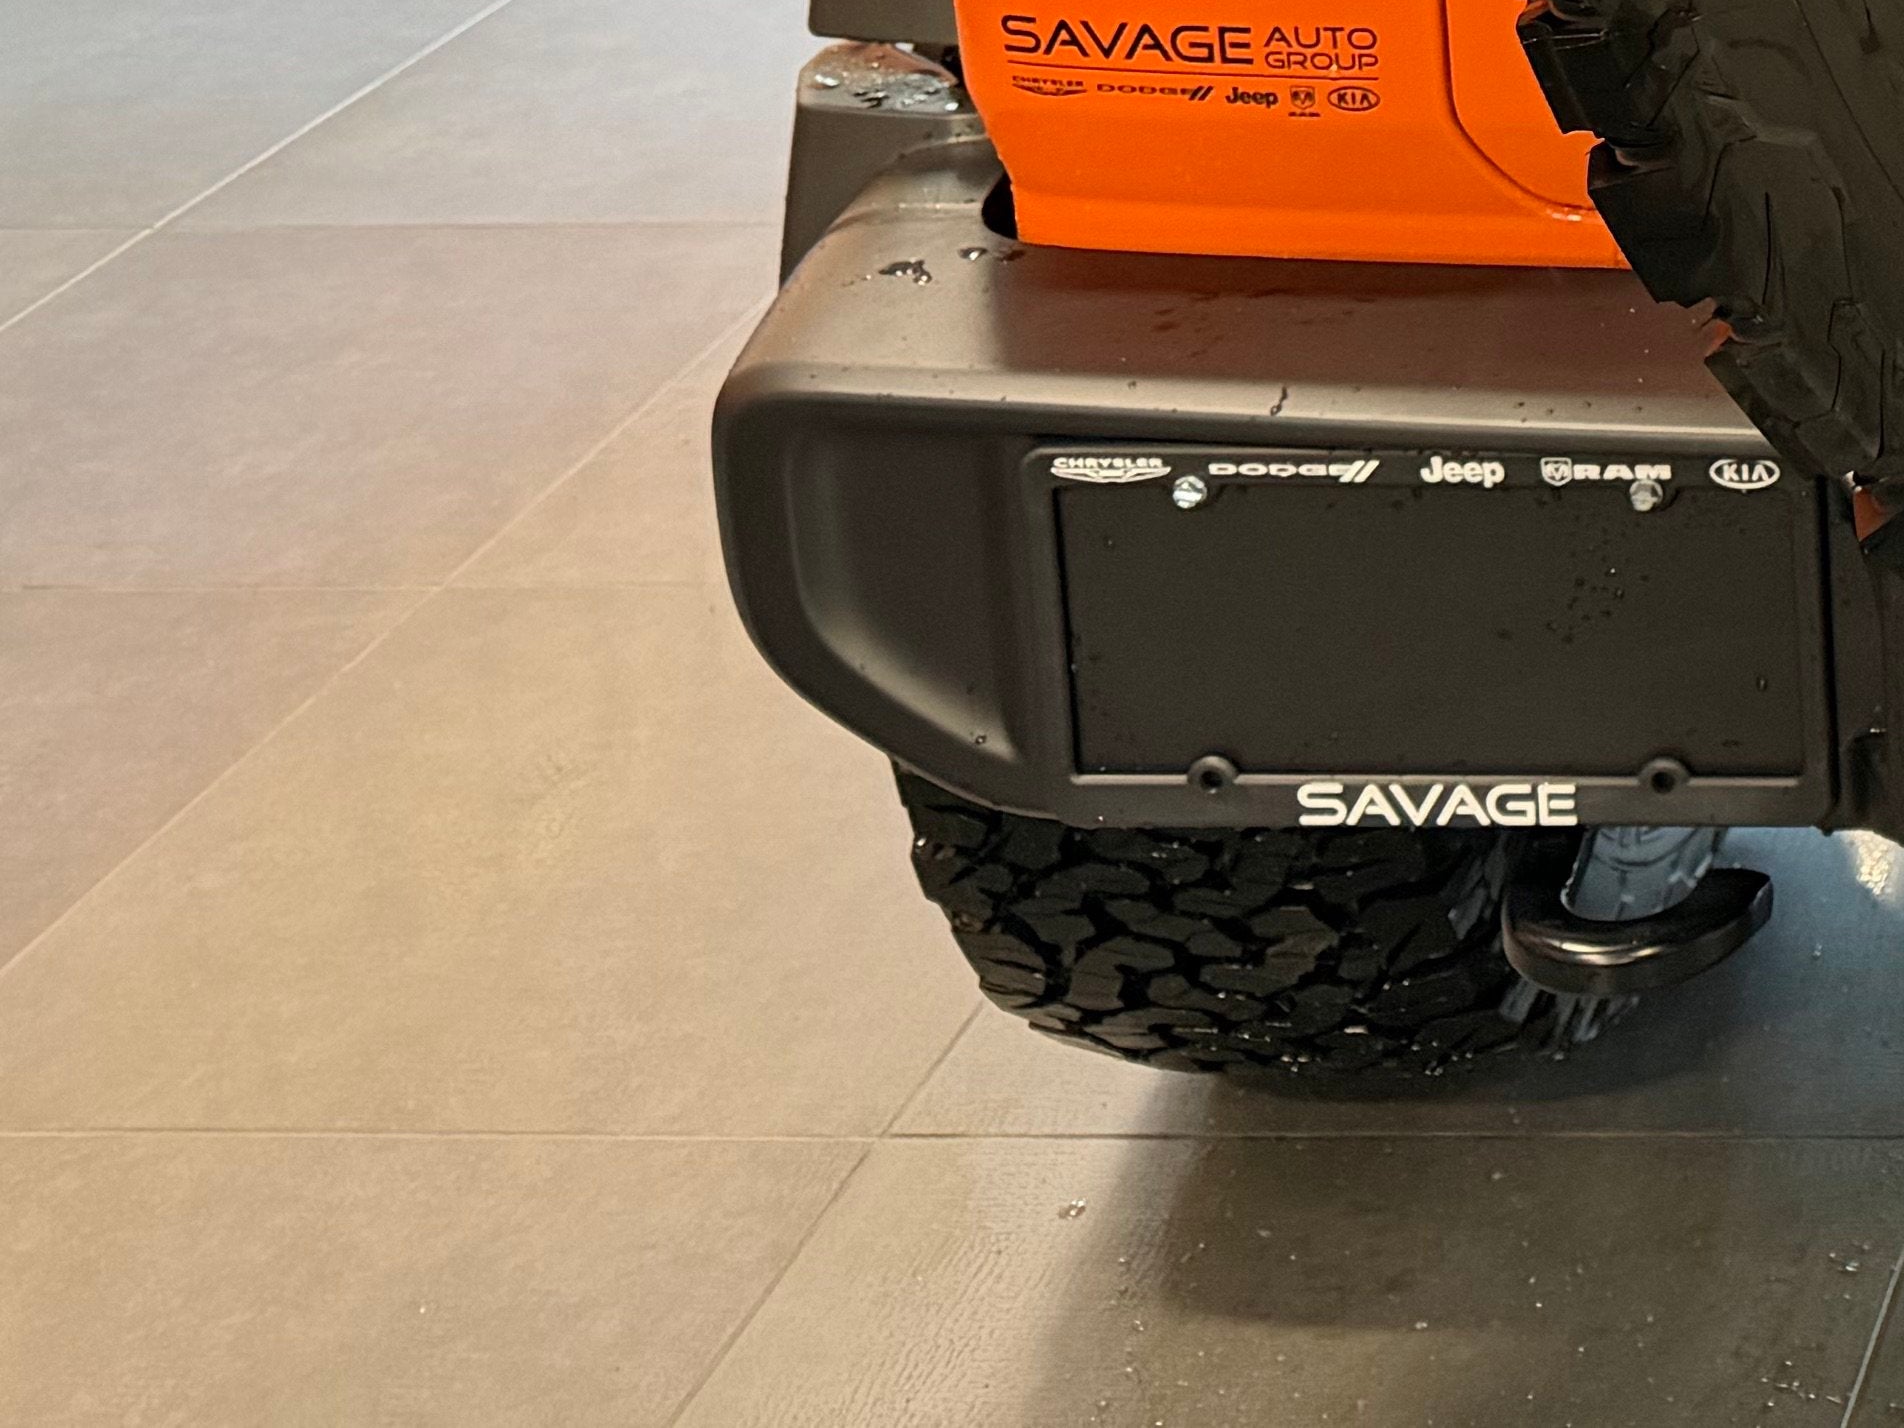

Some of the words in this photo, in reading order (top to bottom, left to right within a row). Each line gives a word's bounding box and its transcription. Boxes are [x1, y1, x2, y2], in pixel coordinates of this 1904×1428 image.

[1001, 15, 1253, 64] SAVAGE
[1264, 26, 1377, 50] AUTO
[1265, 51, 1379, 70] GROUP
[1012, 75, 1084, 87] CHRYSLER
[1096, 83, 1194, 96] DODGE
[1225, 87, 1278, 107] Jeep
[1053, 457, 1163, 468] CHRYSLER
[1208, 463, 1350, 476] DODGE
[1420, 456, 1505, 488] Jeep
[1573, 464, 1672, 480] RAM
[1297, 783, 1578, 827] SAVAGE
